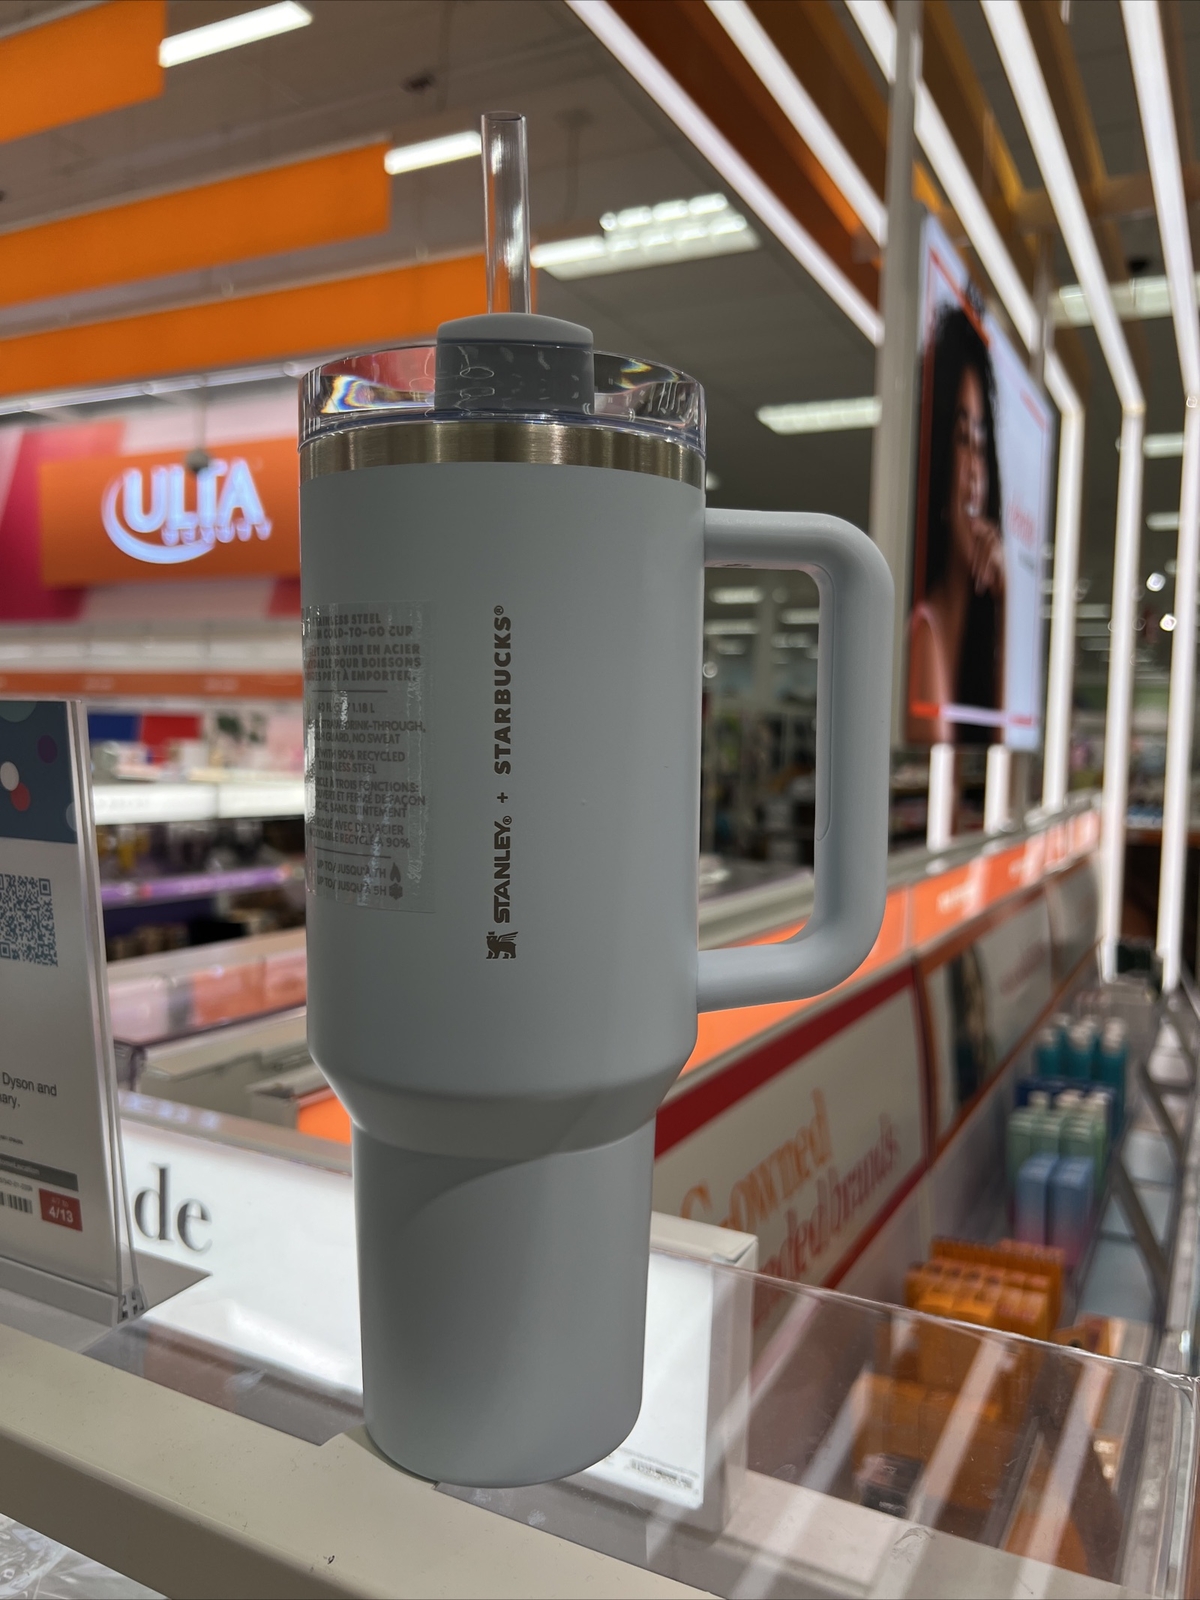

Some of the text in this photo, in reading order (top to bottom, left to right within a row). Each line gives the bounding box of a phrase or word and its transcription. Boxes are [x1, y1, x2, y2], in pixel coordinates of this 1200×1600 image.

[120, 457, 267, 532] ULTA
[351, 613, 381, 625] STEEL
[389, 625, 413, 637] CUP
[342, 645, 364, 656] VIDE
[367, 644, 380, 655] EN
[384, 643, 420, 655] ACIER
[334, 657, 358, 668] POUR
[342, 668, 349, 681] À
[352, 732, 366, 743] NO
[368, 733, 400, 744] SWEAT
[337, 749, 355, 760] 90%
[358, 750, 405, 762] RECYCLED
[352, 763, 377, 774] STEEL
[336, 779, 357, 790] TROIS
[337, 791, 344, 801] ET
[334, 820, 353, 832] AVEC
[386, 838, 411, 849] 90%
[373, 885, 386, 896] 5H
[2, 1071, 57, 1098] Dyson and
[0, 1092, 21, 1110] ary,
[48, 1205, 74, 1223] 4/13
[134, 1163, 213, 1253] de
